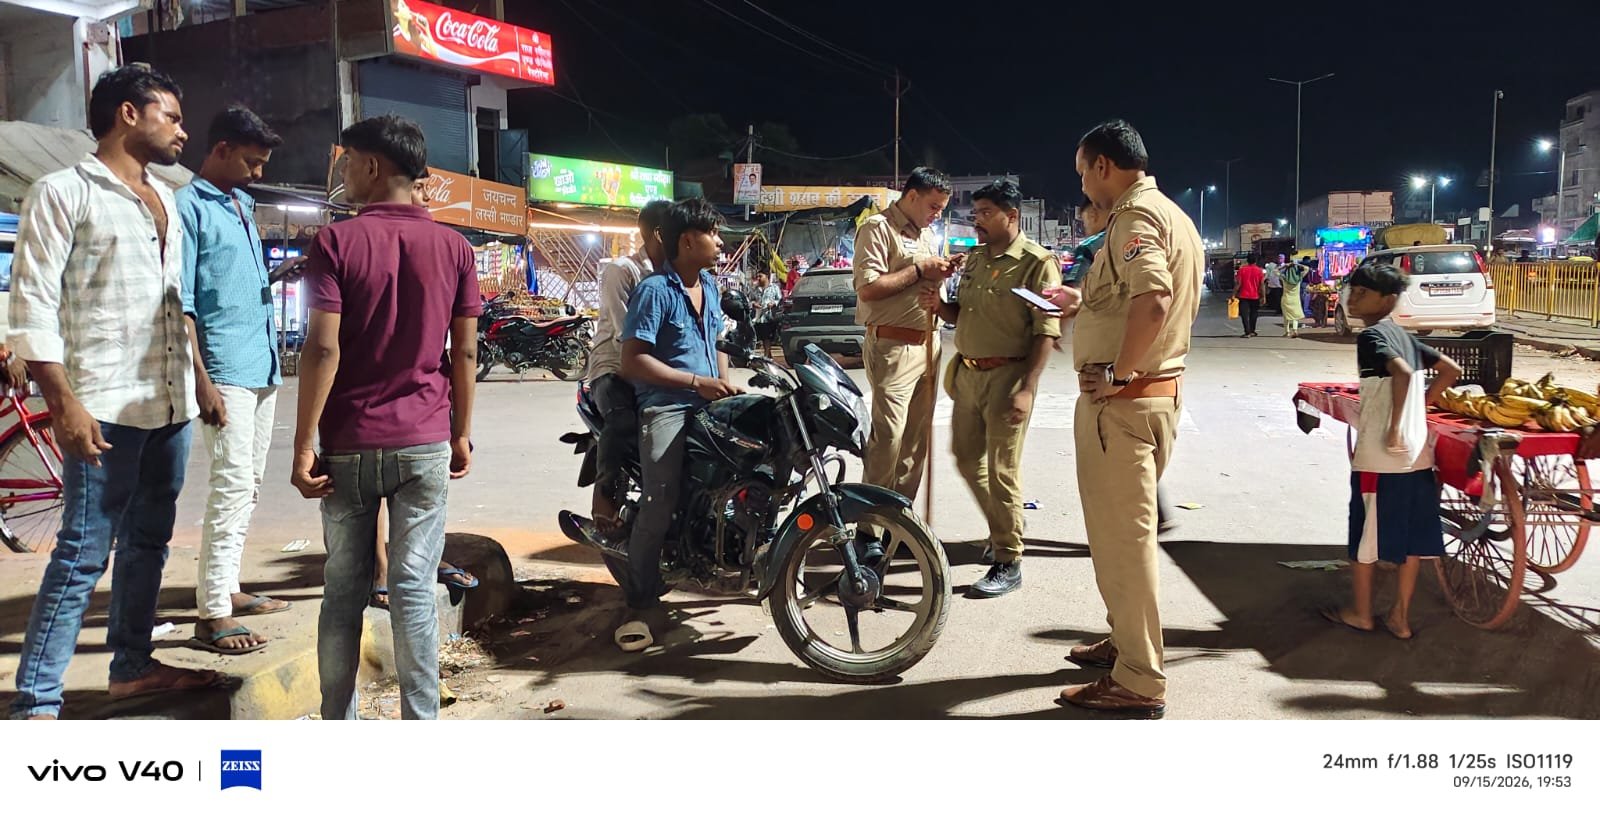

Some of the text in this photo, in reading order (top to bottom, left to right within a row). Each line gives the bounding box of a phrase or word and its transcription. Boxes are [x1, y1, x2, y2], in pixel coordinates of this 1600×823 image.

[435, 11, 500, 53] Coca-Cola
[482, 188, 517, 208] जयचन्द
[475, 206, 497, 224] लस्सी
